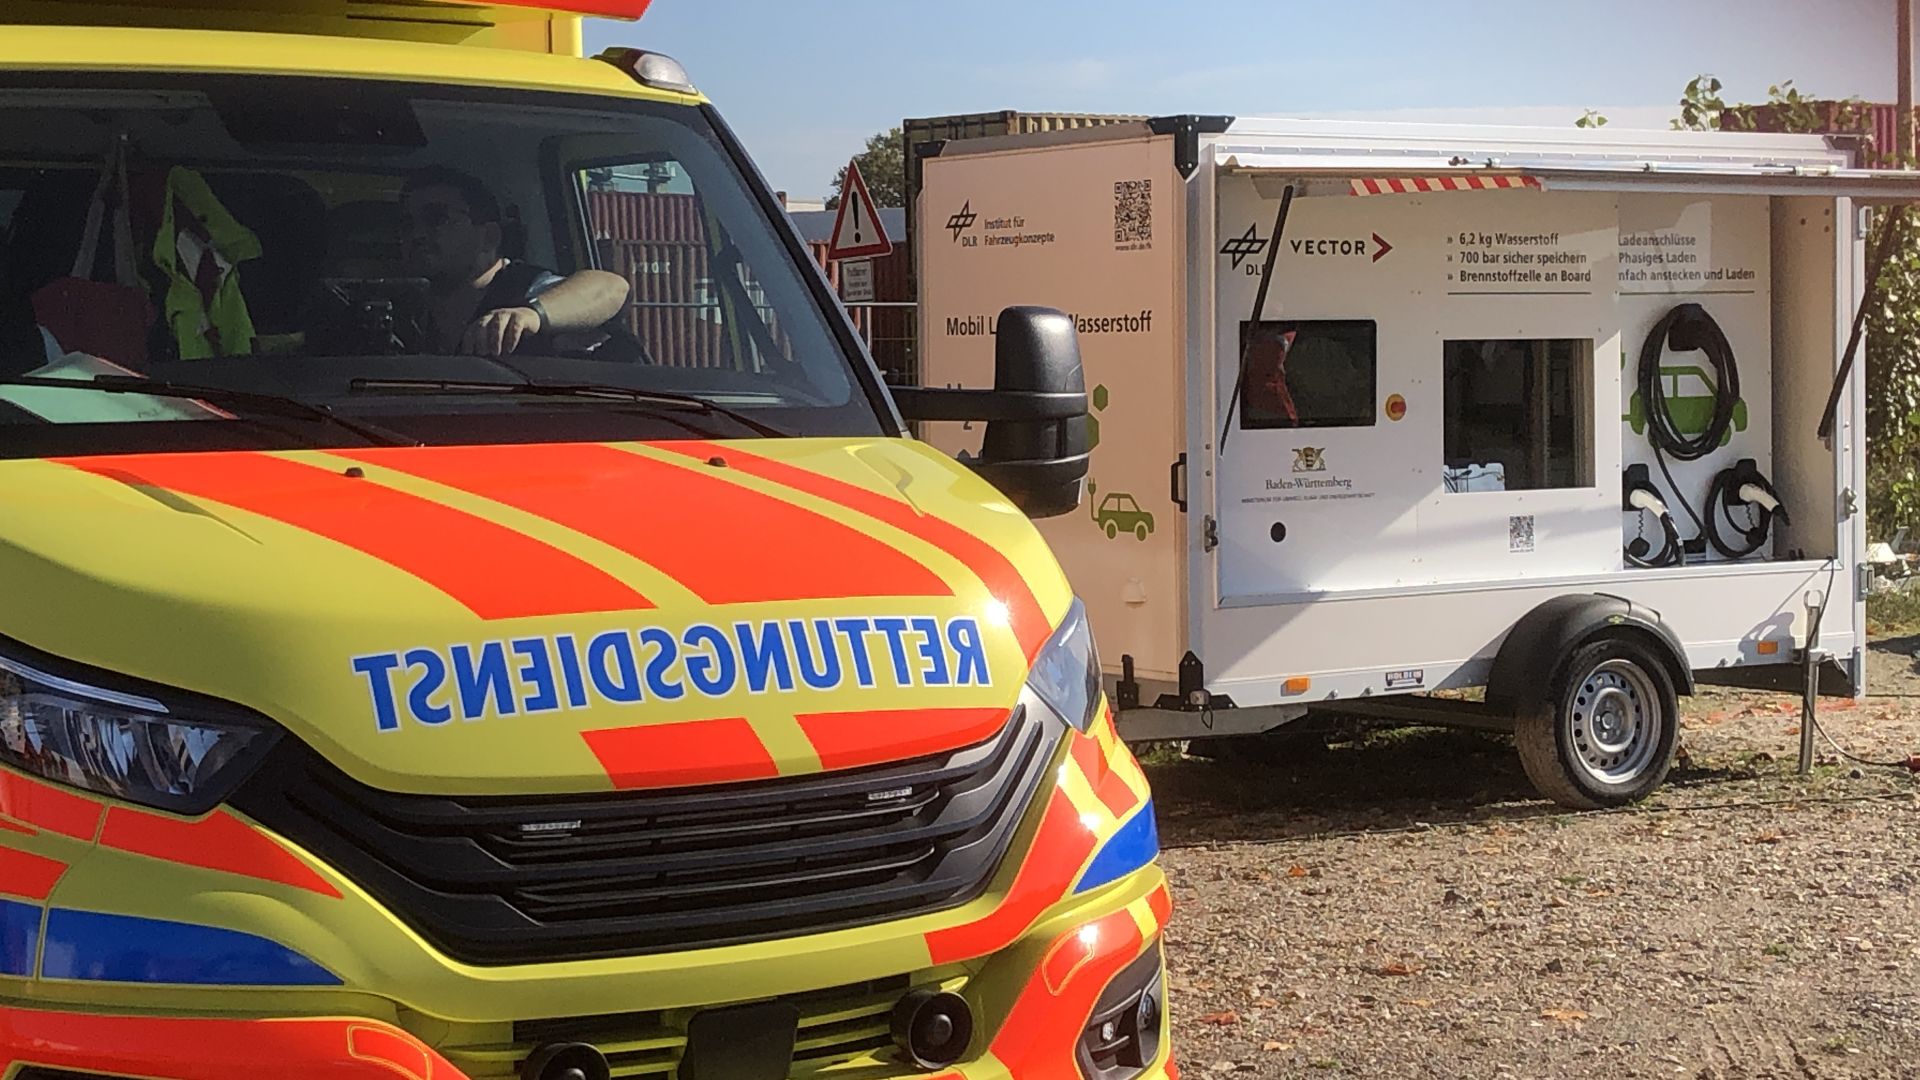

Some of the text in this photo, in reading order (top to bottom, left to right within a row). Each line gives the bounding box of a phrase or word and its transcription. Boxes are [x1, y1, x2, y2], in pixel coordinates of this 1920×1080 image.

[985, 216, 1025, 229] Institut für
[963, 236, 977, 247] DLR
[985, 232, 1055, 247] Fahrzeugkonzepte
[1459, 232, 1559, 248] 6,2 kg Wasserstoff
[1291, 240, 1366, 256] VECTOR
[1460, 251, 1587, 267] 700 bar sicher speichern
[1619, 251, 1697, 266] Phasiges Laden
[1460, 270, 1591, 283] Brennstoffzelle an Board
[1650, 270, 1701, 281] anstecken
[1704, 268, 1723, 280] und
[1726, 268, 1755, 280] Laden
[946, 316, 985, 336] Mobil
[1265, 476, 1352, 490] Baden-Württemberg
